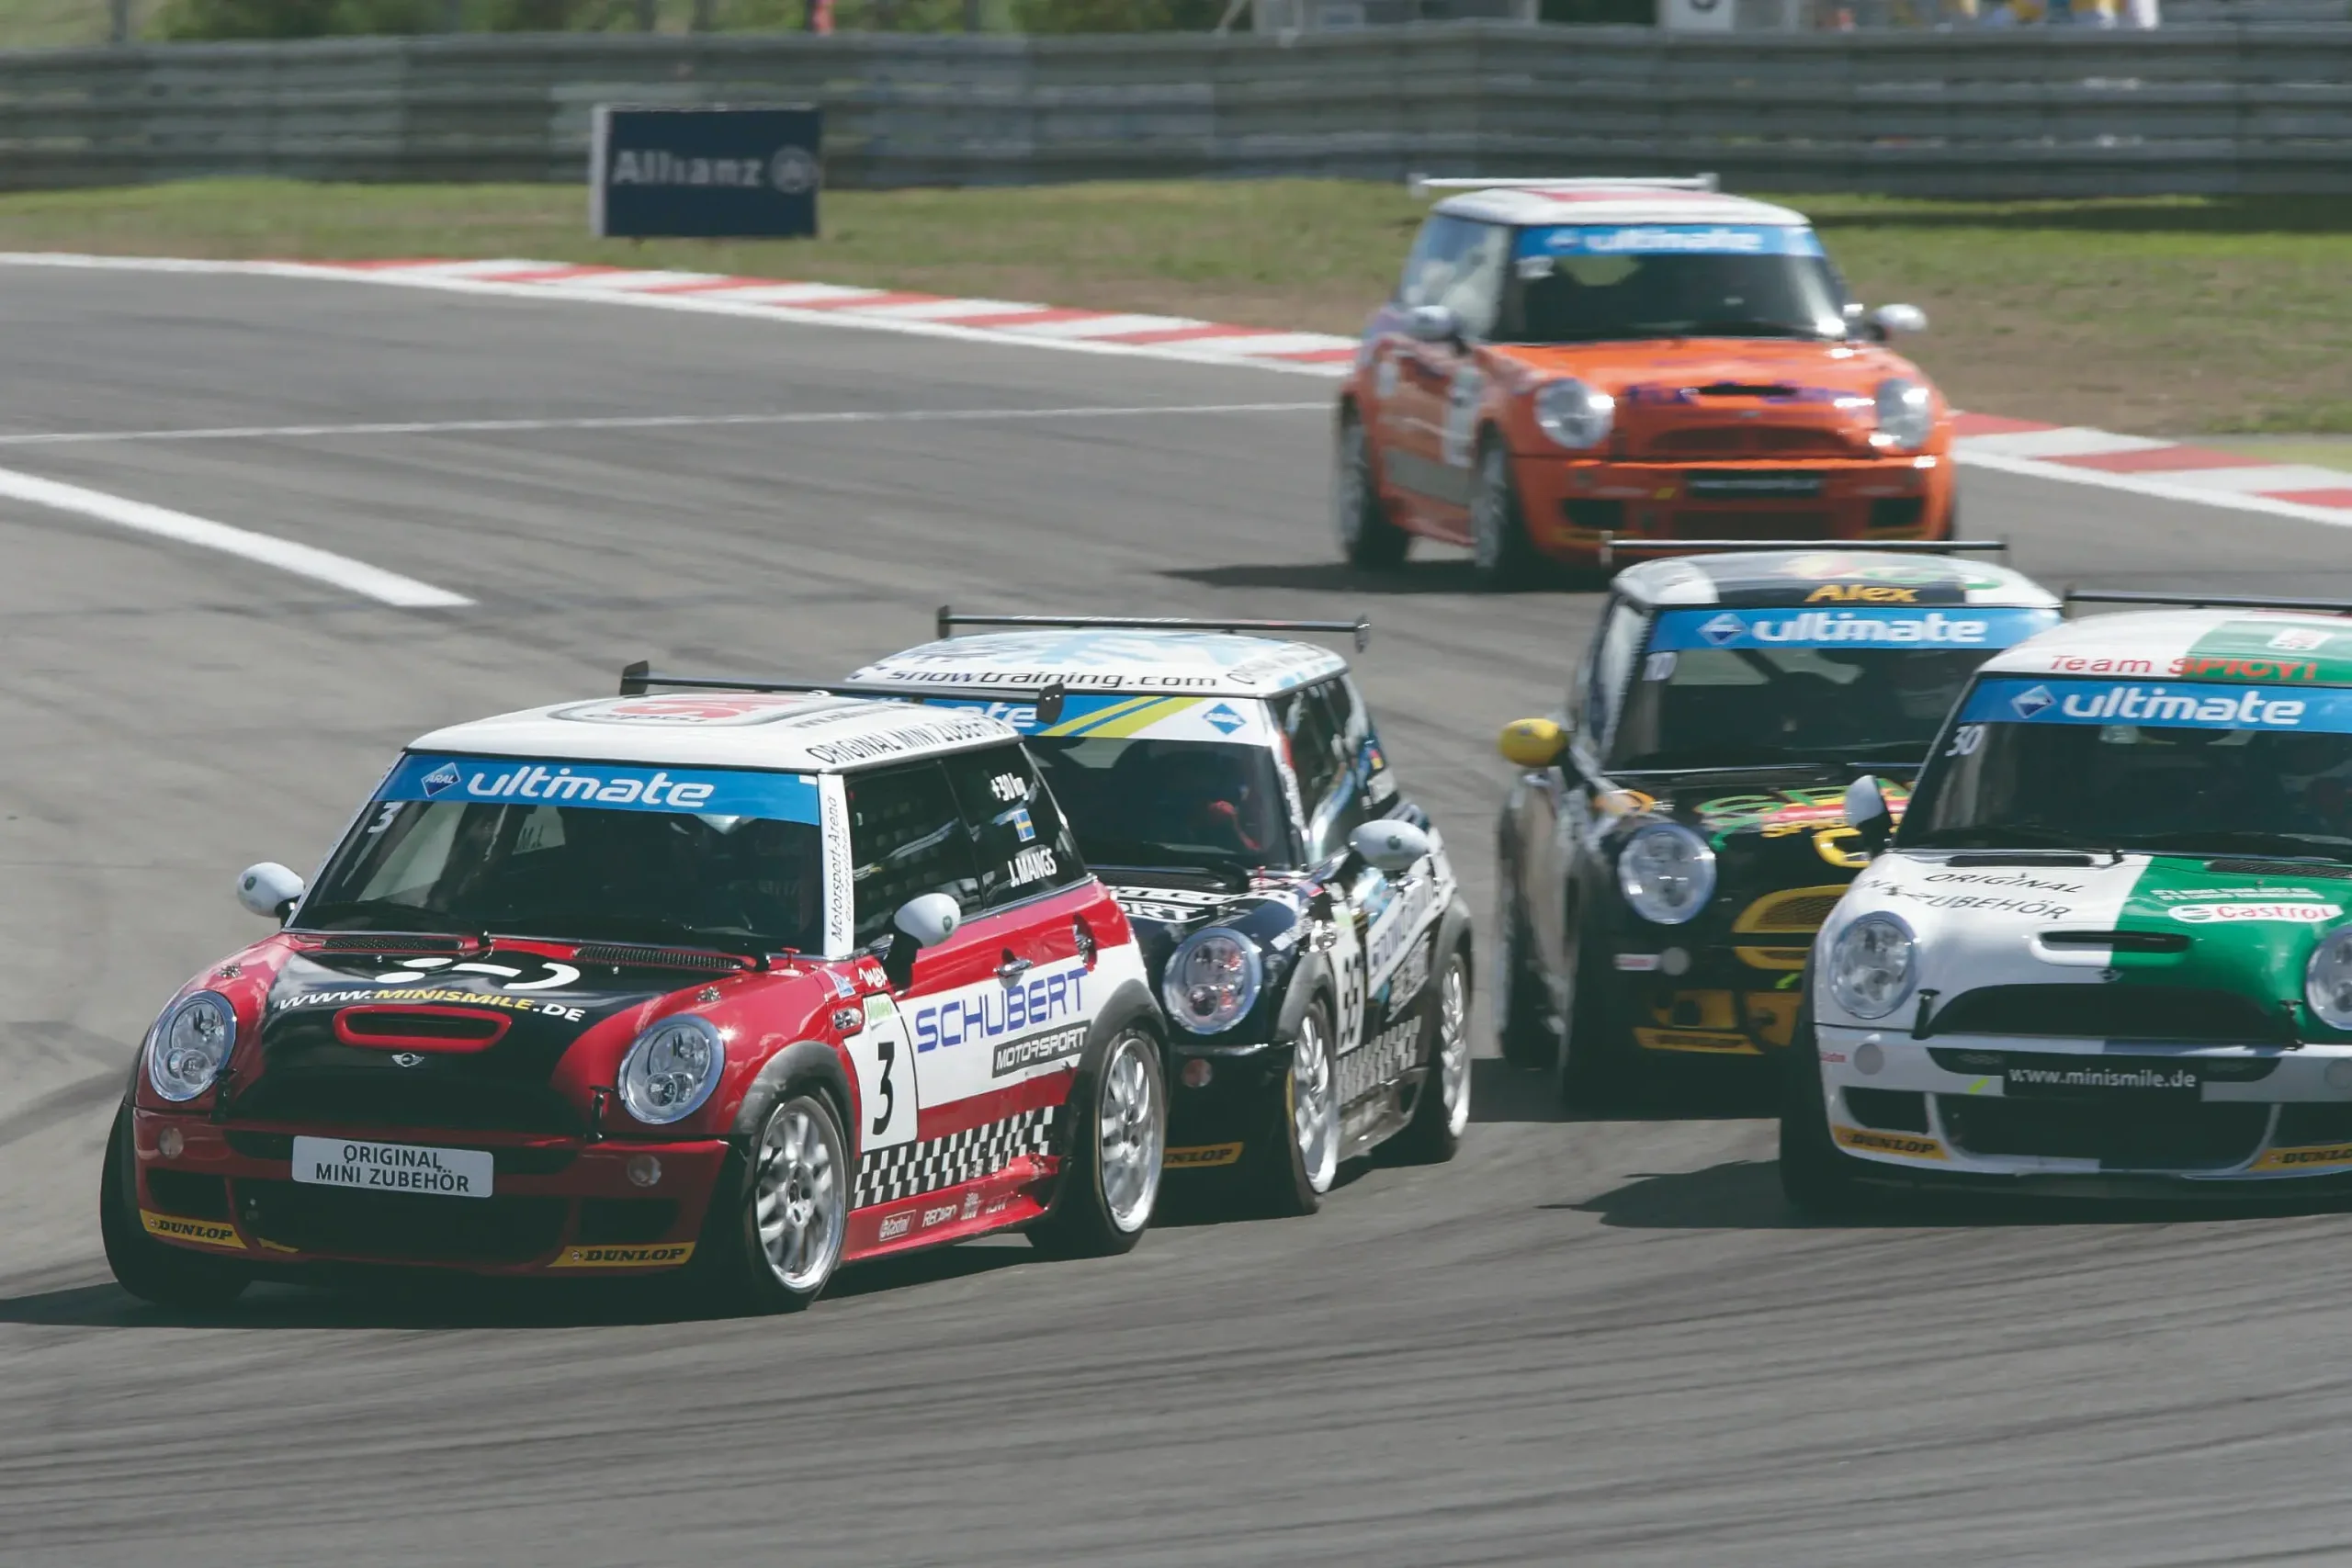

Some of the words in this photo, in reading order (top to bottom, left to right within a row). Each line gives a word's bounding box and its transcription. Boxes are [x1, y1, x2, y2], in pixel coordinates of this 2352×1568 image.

[613, 150, 763, 186] Allianz
[1804, 584, 1920, 604] Alex
[1750, 612, 1989, 643] ultimate
[888, 669, 1216, 689] snowtraining.com
[2050, 654, 2151, 674] Team
[2062, 686, 2305, 726] ultimate
[806, 728, 903, 764] ORIGINAL
[1945, 726, 1985, 758] 30
[424, 773, 454, 786] ARAL
[467, 766, 715, 808] ultimate
[368, 802, 403, 833] 3
[1924, 873, 2086, 893] ORIGINAL
[2216, 906, 2332, 919] Castrol
[279, 988, 586, 1022] WWW.MINISMILE.DE
[915, 967, 1088, 1054] SCHUBERT
[996, 1026, 1088, 1071] MOTORSPORT
[872, 1042, 896, 1135] 3
[2008, 1067, 2197, 1088] www.minismile.de
[343, 1145, 443, 1170] ORIGINAL
[1850, 1134, 1936, 1153] DUNLOP
[315, 1163, 361, 1183] MINI
[368, 1167, 469, 1192] ZUBEHÖR
[157, 1219, 233, 1240] DUNLOP
[583, 1248, 686, 1262] DUNLOP
